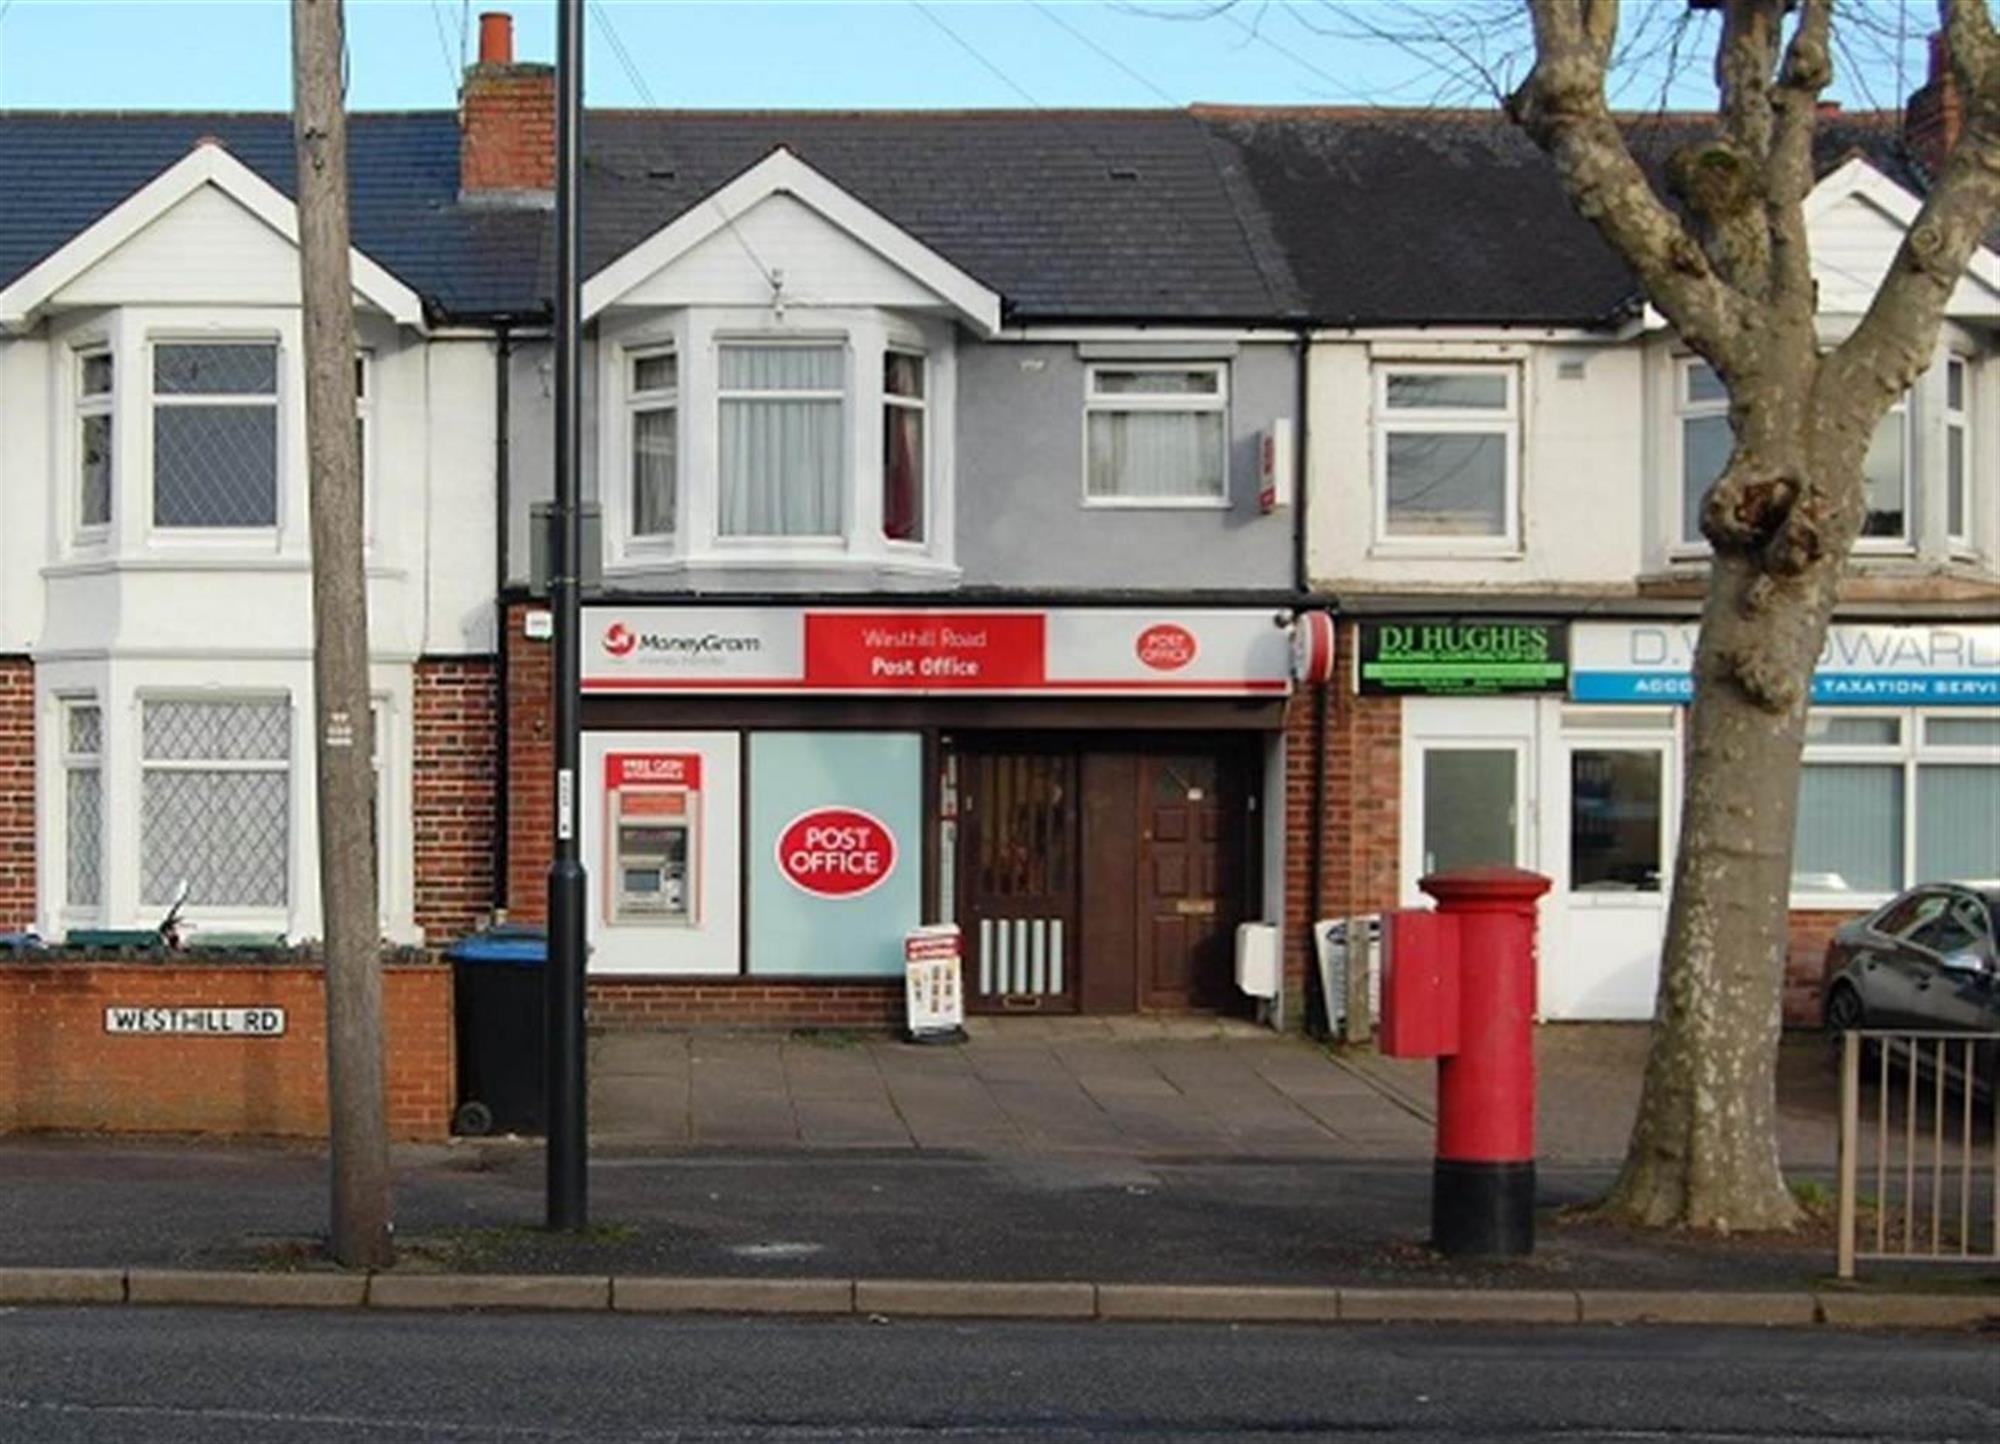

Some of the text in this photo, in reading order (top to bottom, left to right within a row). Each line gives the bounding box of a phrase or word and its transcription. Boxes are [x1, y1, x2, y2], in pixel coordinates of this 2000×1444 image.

[638, 634, 760, 656] MoneyGram
[861, 627, 987, 648] Westhill Road
[1379, 626, 1548, 651] DJ HUGHES
[872, 656, 980, 676] Post Office
[1634, 678, 1697, 695] ACCO
[1824, 680, 1927, 695] TAXATION
[805, 826, 871, 850] POST
[788, 850, 880, 875] OFFICE
[115, 1010, 279, 1032] WESTHILL RD
